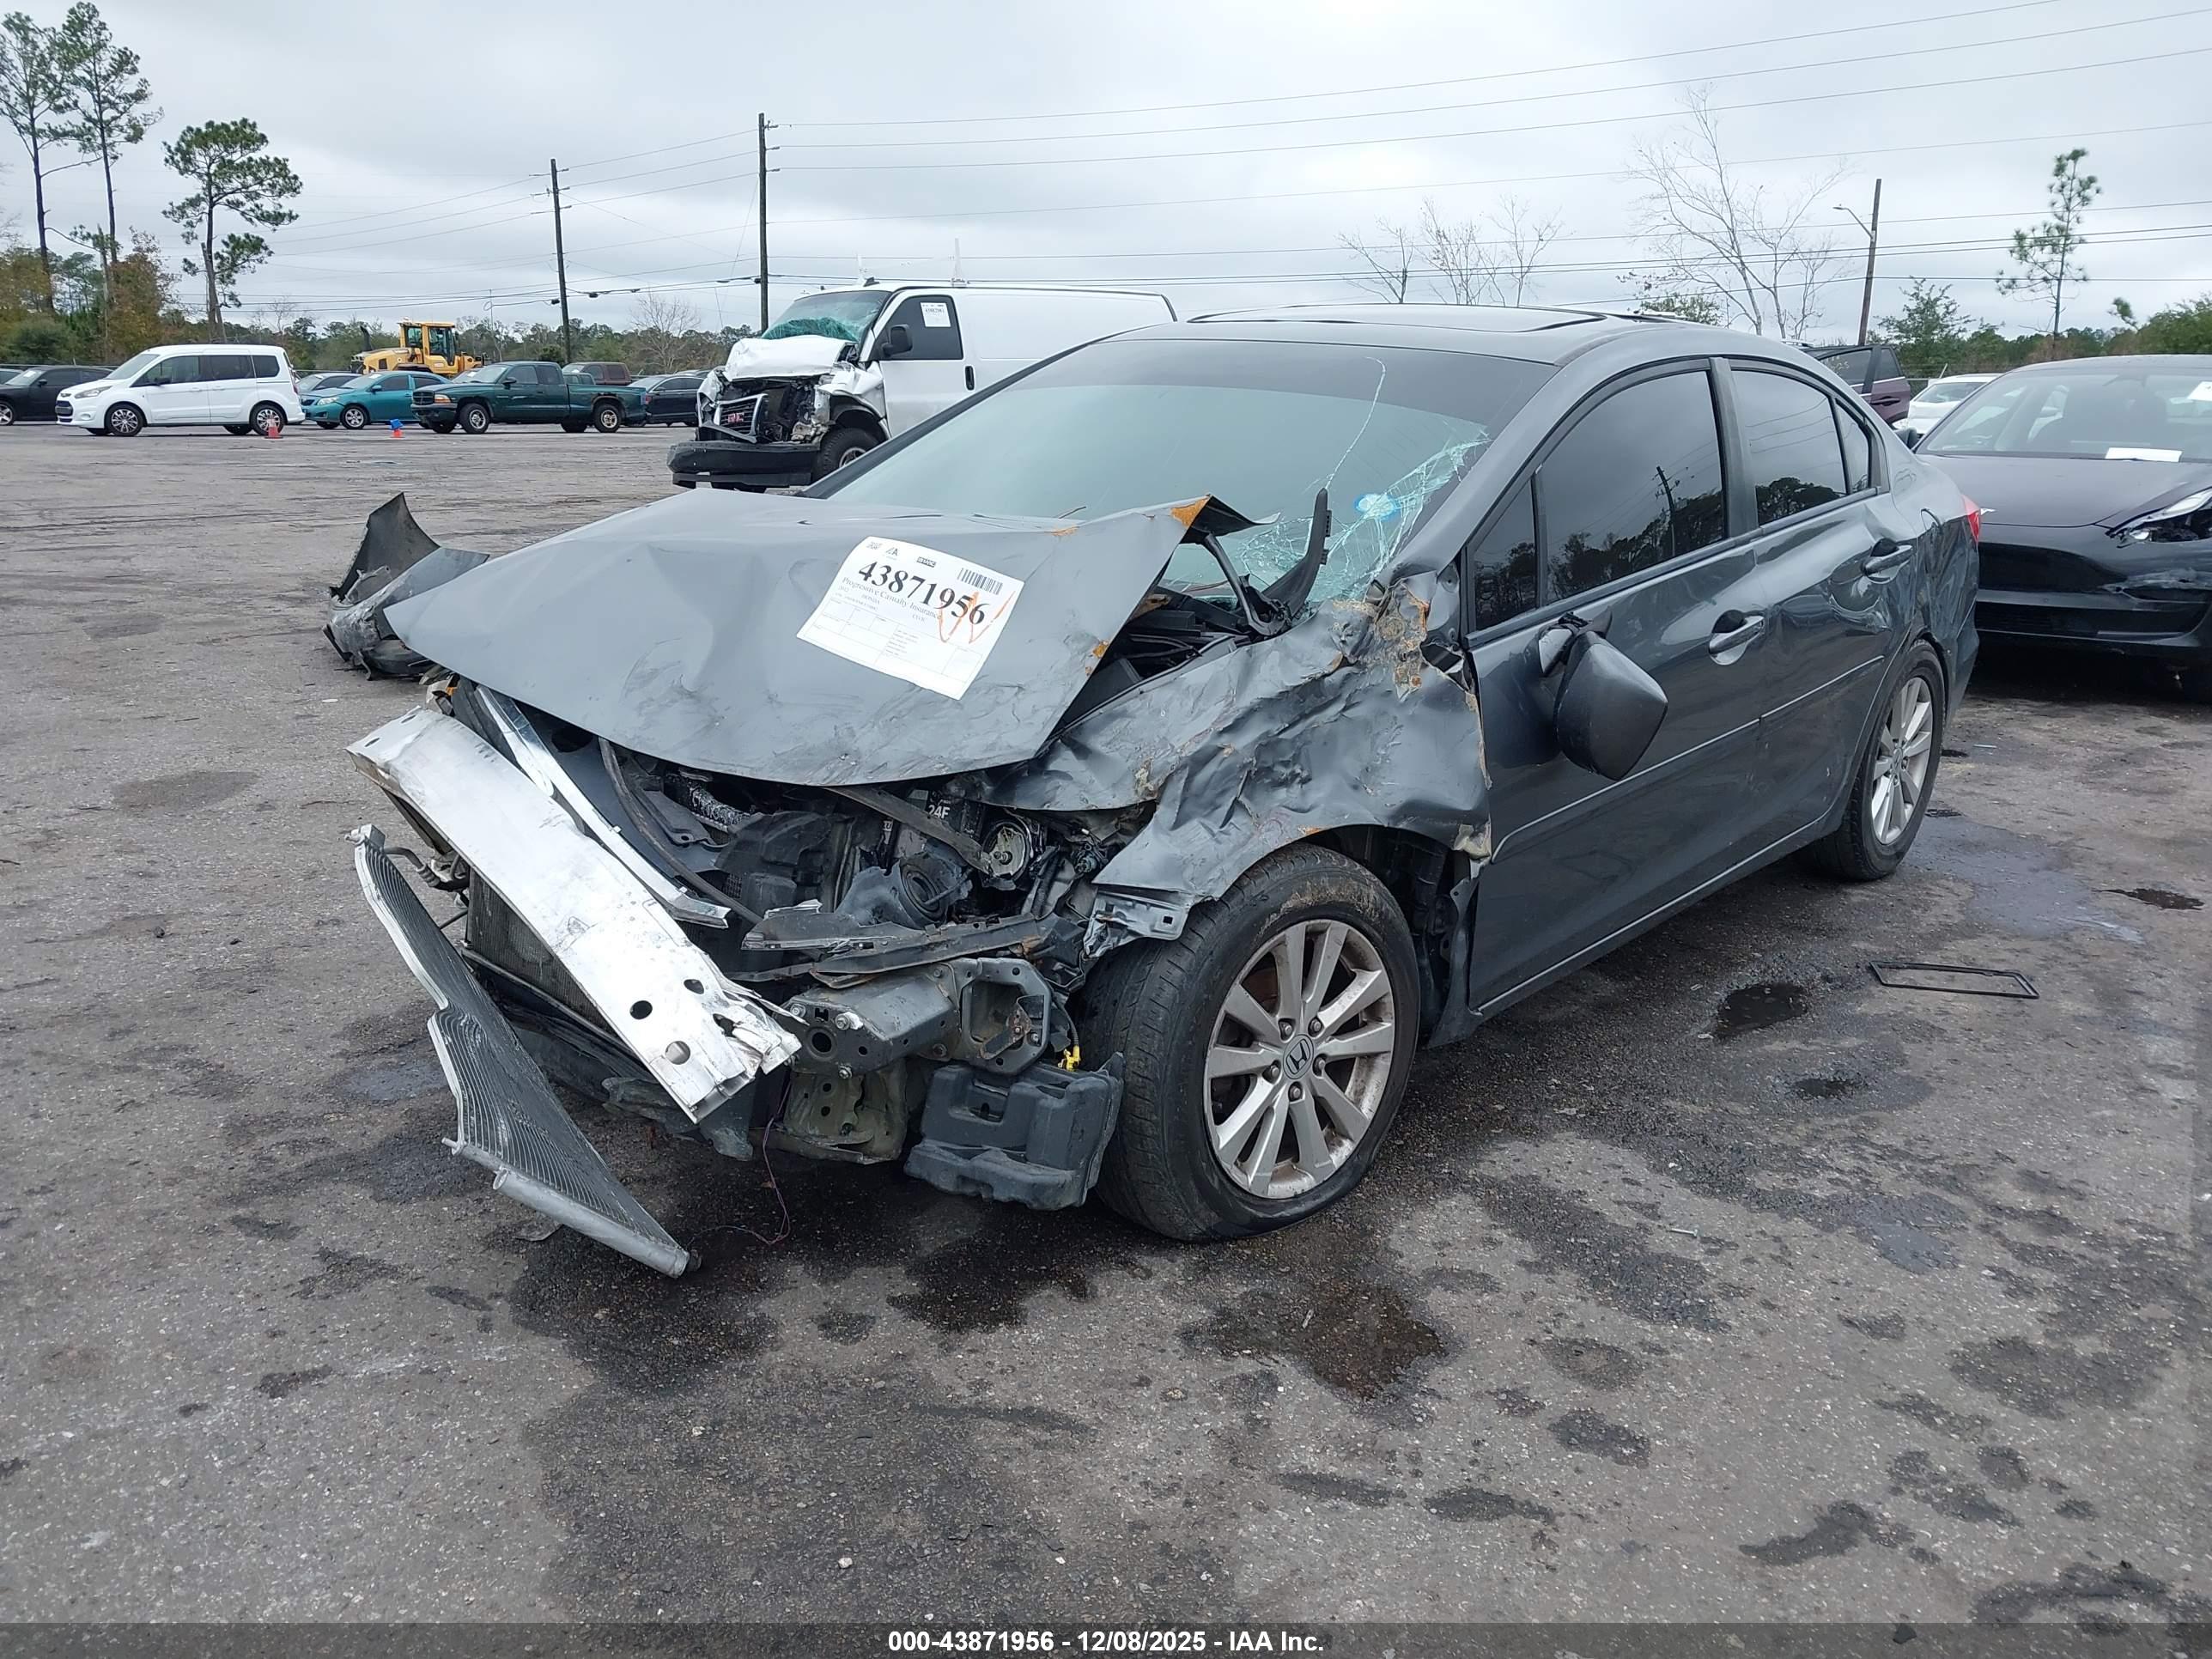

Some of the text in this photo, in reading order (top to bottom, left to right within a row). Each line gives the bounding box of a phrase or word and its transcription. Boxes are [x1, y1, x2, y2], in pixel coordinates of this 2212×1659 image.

[842, 576, 880, 596] Progressive
[880, 589, 908, 608] Casualty
[909, 601, 943, 620] Insurance
[859, 561, 992, 625] 43871956
[928, 804, 951, 819] 24F
